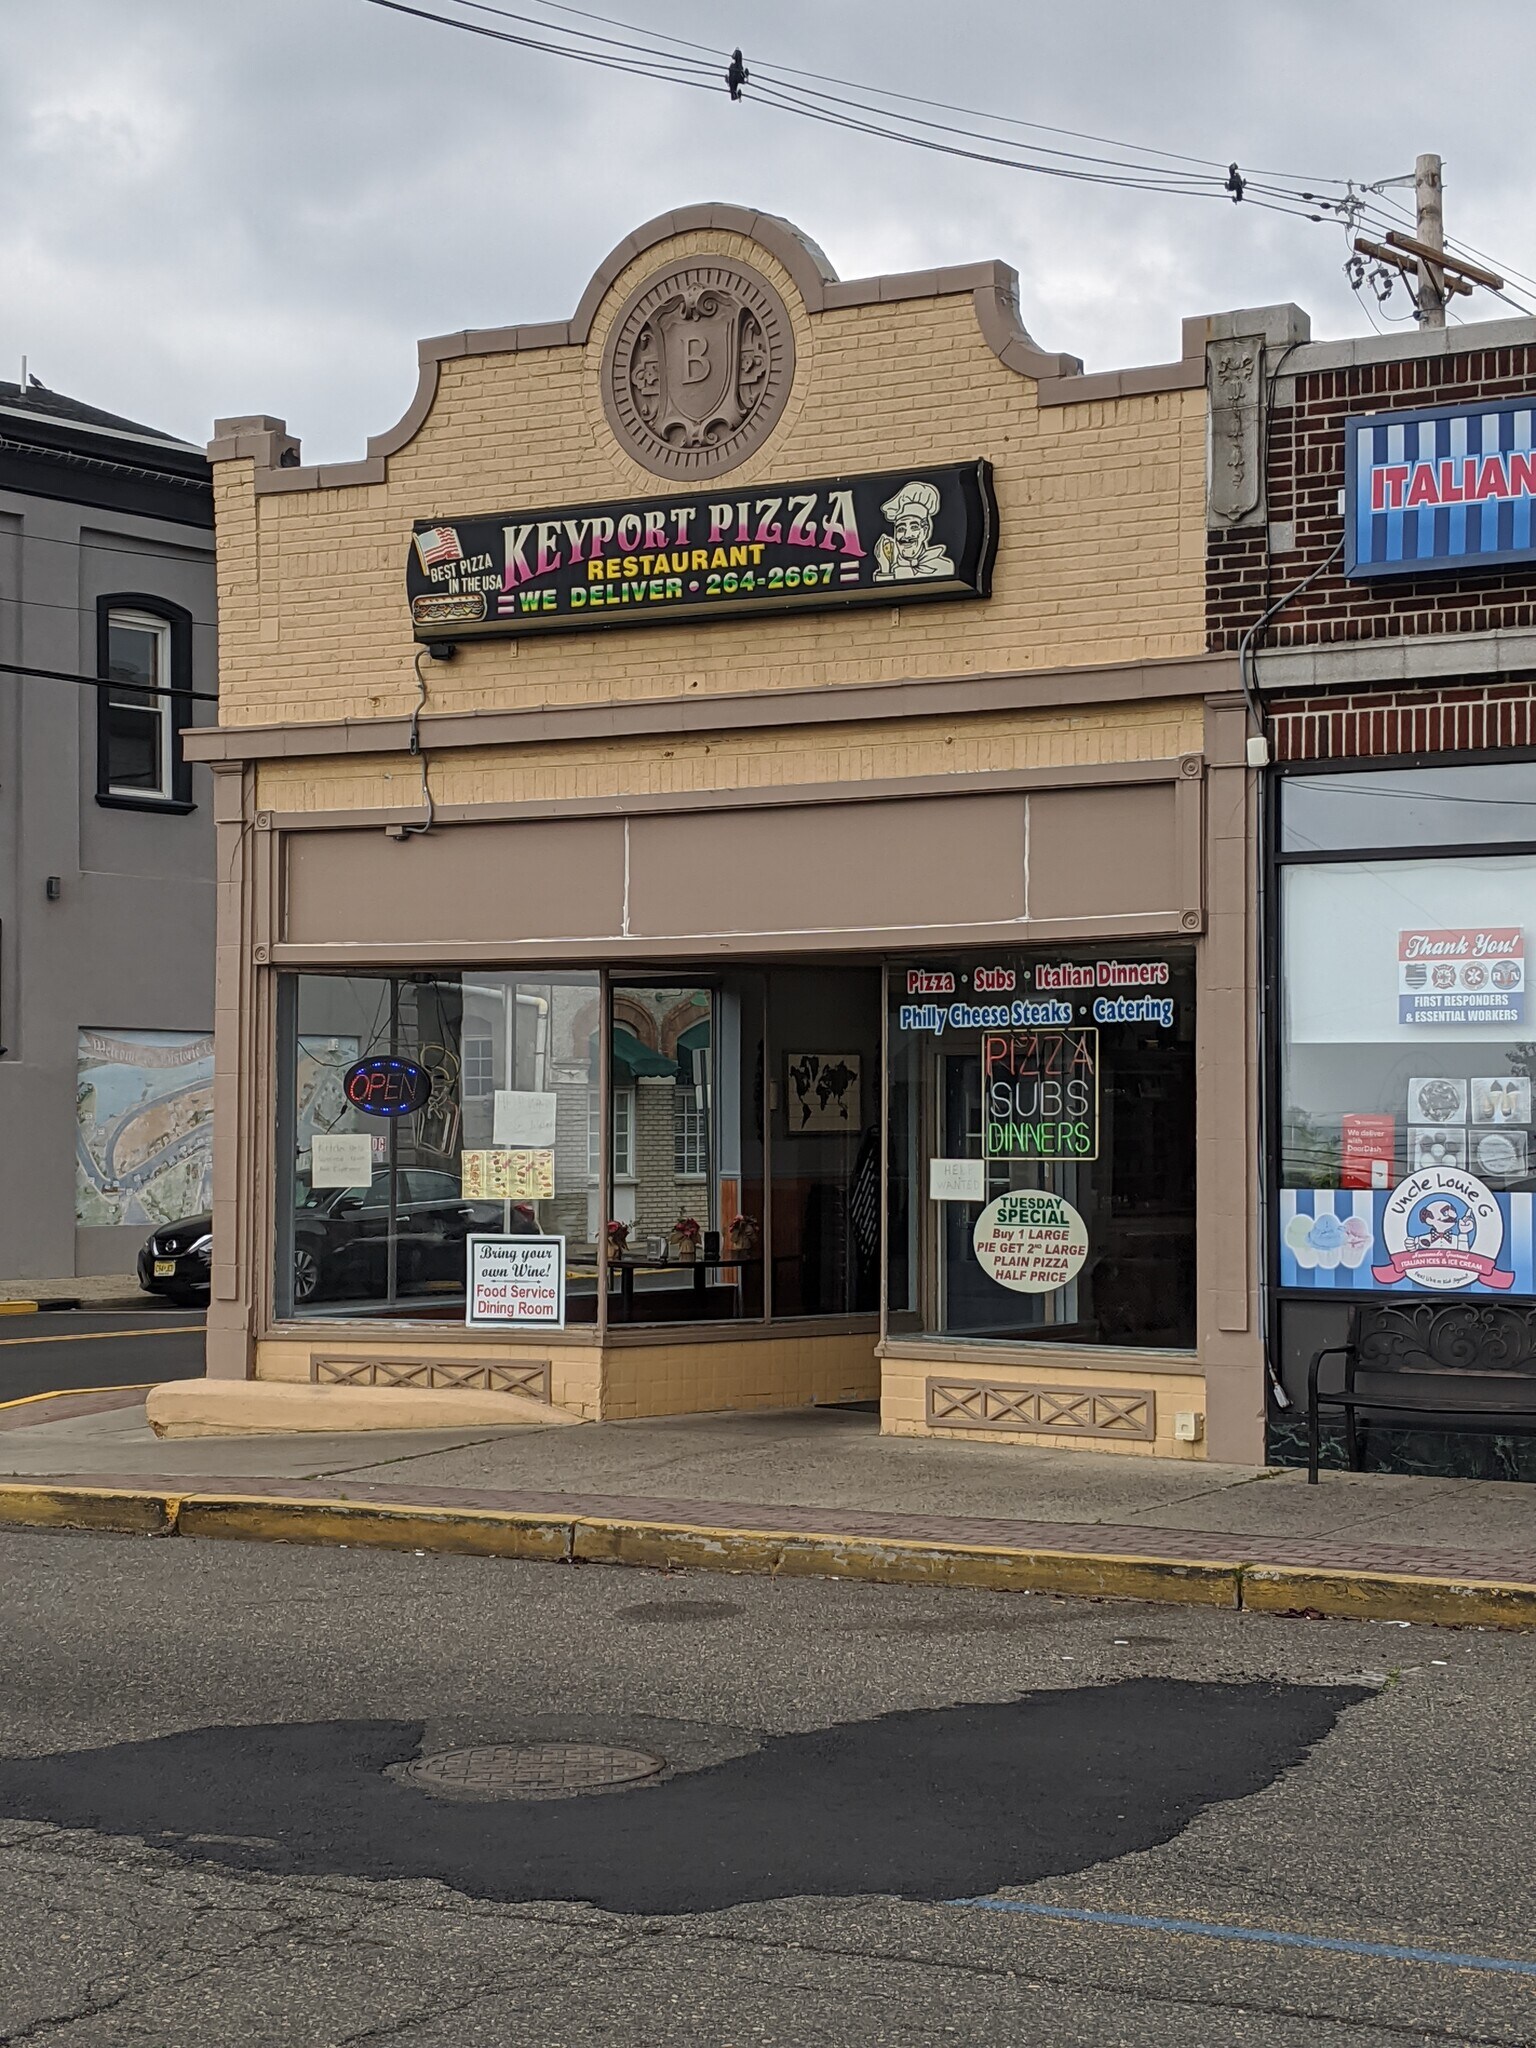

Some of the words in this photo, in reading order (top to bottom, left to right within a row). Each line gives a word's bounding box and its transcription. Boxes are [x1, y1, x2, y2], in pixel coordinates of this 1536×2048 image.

[680, 337, 712, 386] B
[1371, 451, 1536, 512] ITALIAN
[500, 505, 697, 593] KEYPORT
[707, 490, 868, 557] PIZZA
[430, 562, 456, 583] BEST
[460, 552, 493, 575] PIZZA
[588, 543, 766, 581] RESTAURANT
[449, 577, 460, 594] IN
[461, 575, 482, 593] THE
[482, 573, 503, 592] USA
[519, 588, 557, 612] WE
[570, 576, 683, 608] DELIVER
[705, 562, 835, 596] 264-2667
[1405, 935, 1469, 958] Thank
[1471, 933, 1520, 957] You!
[907, 969, 955, 994] Pizza
[974, 966, 1016, 991] Subs
[1035, 962, 1095, 989] Italian
[1096, 960, 1169, 987] Dinners
[1414, 995, 1442, 1008] FIRST
[1444, 994, 1509, 1007] RESPONDERS
[900, 1005, 948, 1035] Philly
[950, 1002, 1010, 1028] Cheese
[1011, 1000, 1072, 1025] Steaks
[1093, 995, 1173, 1028] Catering
[1405, 1012, 1413, 1023] &
[1415, 1010, 1466, 1022] ESSENTIAL
[1467, 1009, 1518, 1022] WORKERS
[986, 1035, 1095, 1076] PIZZA
[350, 1073, 418, 1101] OPEN
[990, 1080, 1089, 1118] SUBS
[988, 1122, 1091, 1153] DINNERS
[1361, 1129, 1385, 1137] deliver
[1347, 1144, 1382, 1152] DoorDash
[1000, 1197, 1062, 1210] TUESDAY
[1391, 1176, 1433, 1215] Uncle
[1437, 1173, 1480, 1203] Louie
[1478, 1204, 1494, 1218] G
[997, 1209, 1070, 1224] SPECIAL
[992, 1228, 1014, 1241] Buy
[1018, 1229, 1024, 1239] 1
[1028, 1229, 1070, 1240] LARGE
[480, 1245, 517, 1263] Bring
[521, 1249, 552, 1263] your
[977, 1242, 996, 1252] PIE
[1000, 1242, 1024, 1253] GET
[1045, 1244, 1086, 1255] LARGE
[481, 1267, 508, 1277] own
[512, 1263, 552, 1277] Wine!
[993, 1256, 1030, 1267] PLAIN
[1033, 1257, 1068, 1268] PIZZA
[1401, 1258, 1426, 1268] ITALIAN
[1459, 1260, 1483, 1270] CREAM
[995, 1269, 1027, 1281] HALF
[1029, 1271, 1067, 1282] PRICE
[477, 1284, 507, 1298] Food
[510, 1285, 556, 1299] Service
[478, 1301, 514, 1317] Dining
[518, 1302, 554, 1315] Room
